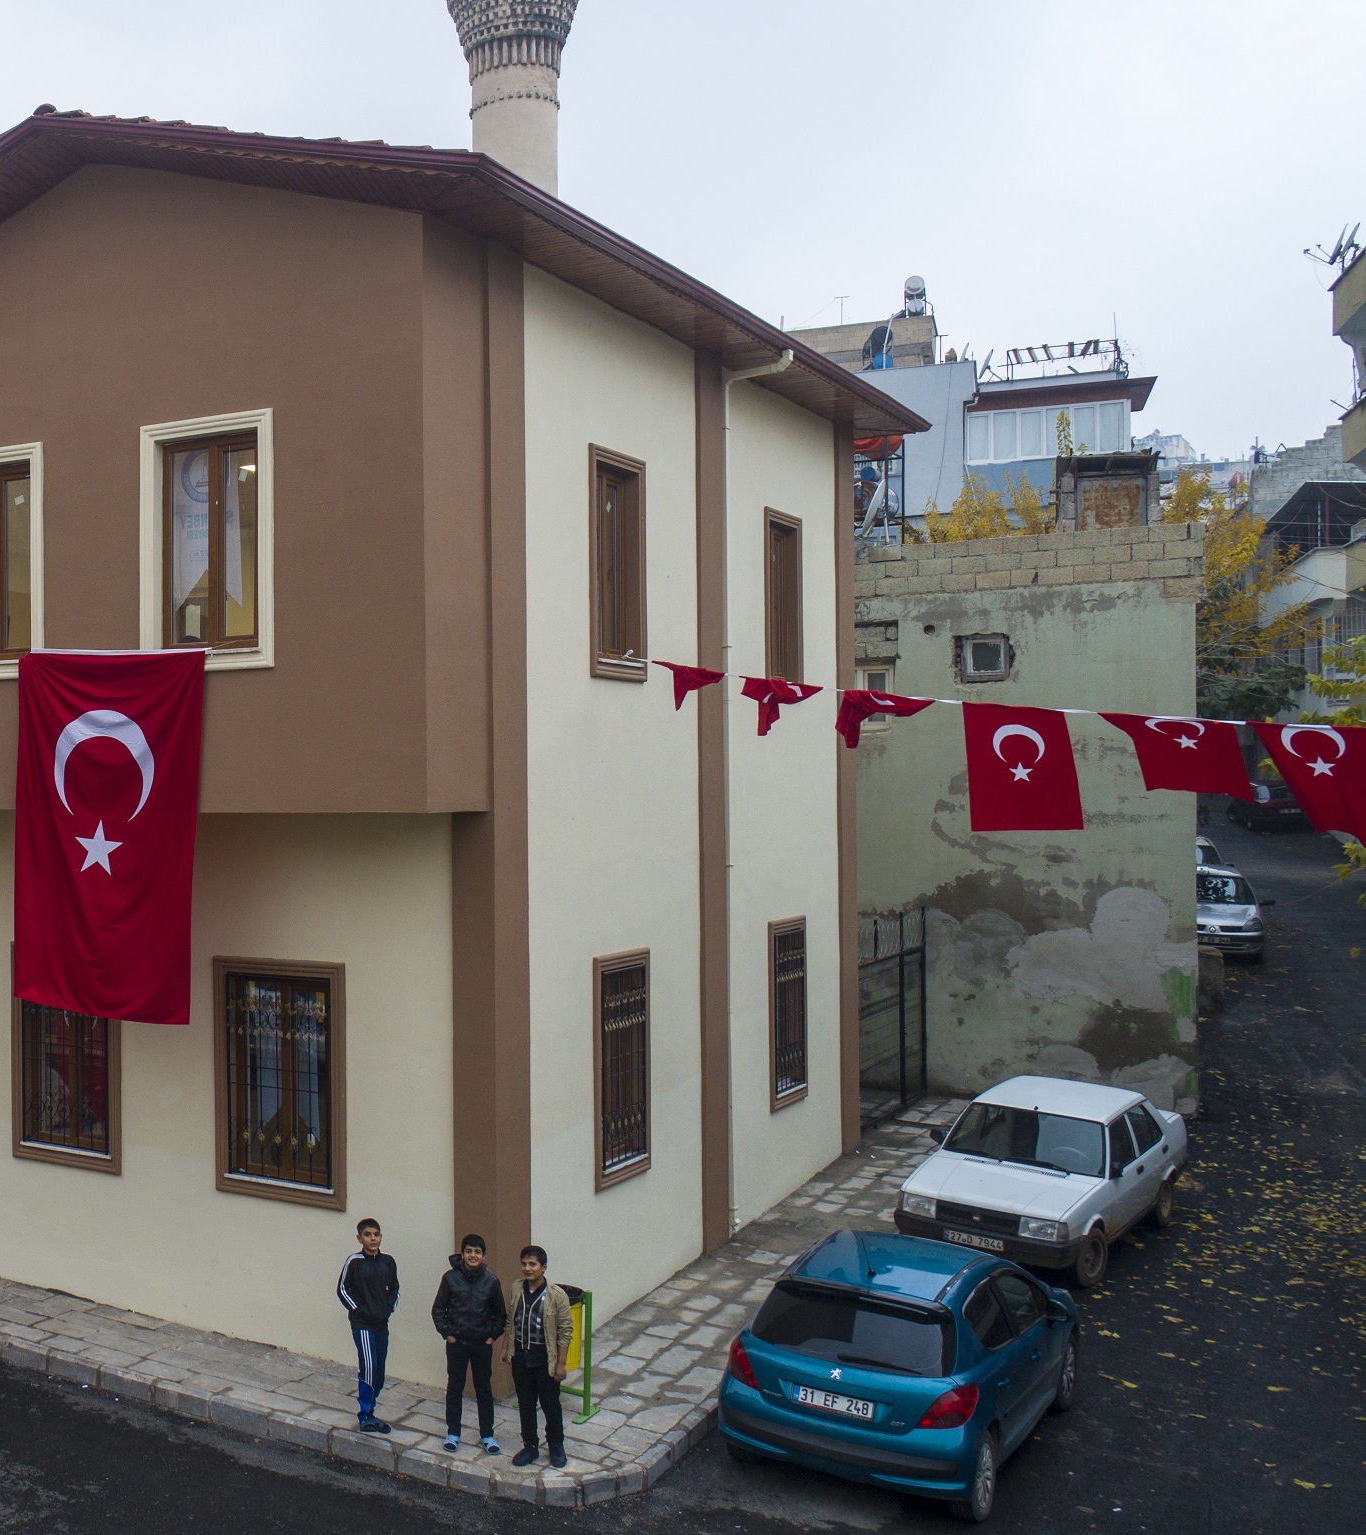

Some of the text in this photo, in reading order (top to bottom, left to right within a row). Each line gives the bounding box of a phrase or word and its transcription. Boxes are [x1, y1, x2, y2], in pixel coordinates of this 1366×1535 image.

[950, 1231, 961, 1241] 27
[978, 1237, 1002, 1250] 7944
[800, 1388, 815, 1403] 31
[823, 1393, 839, 1408] EF
[846, 1398, 870, 1416] 248
